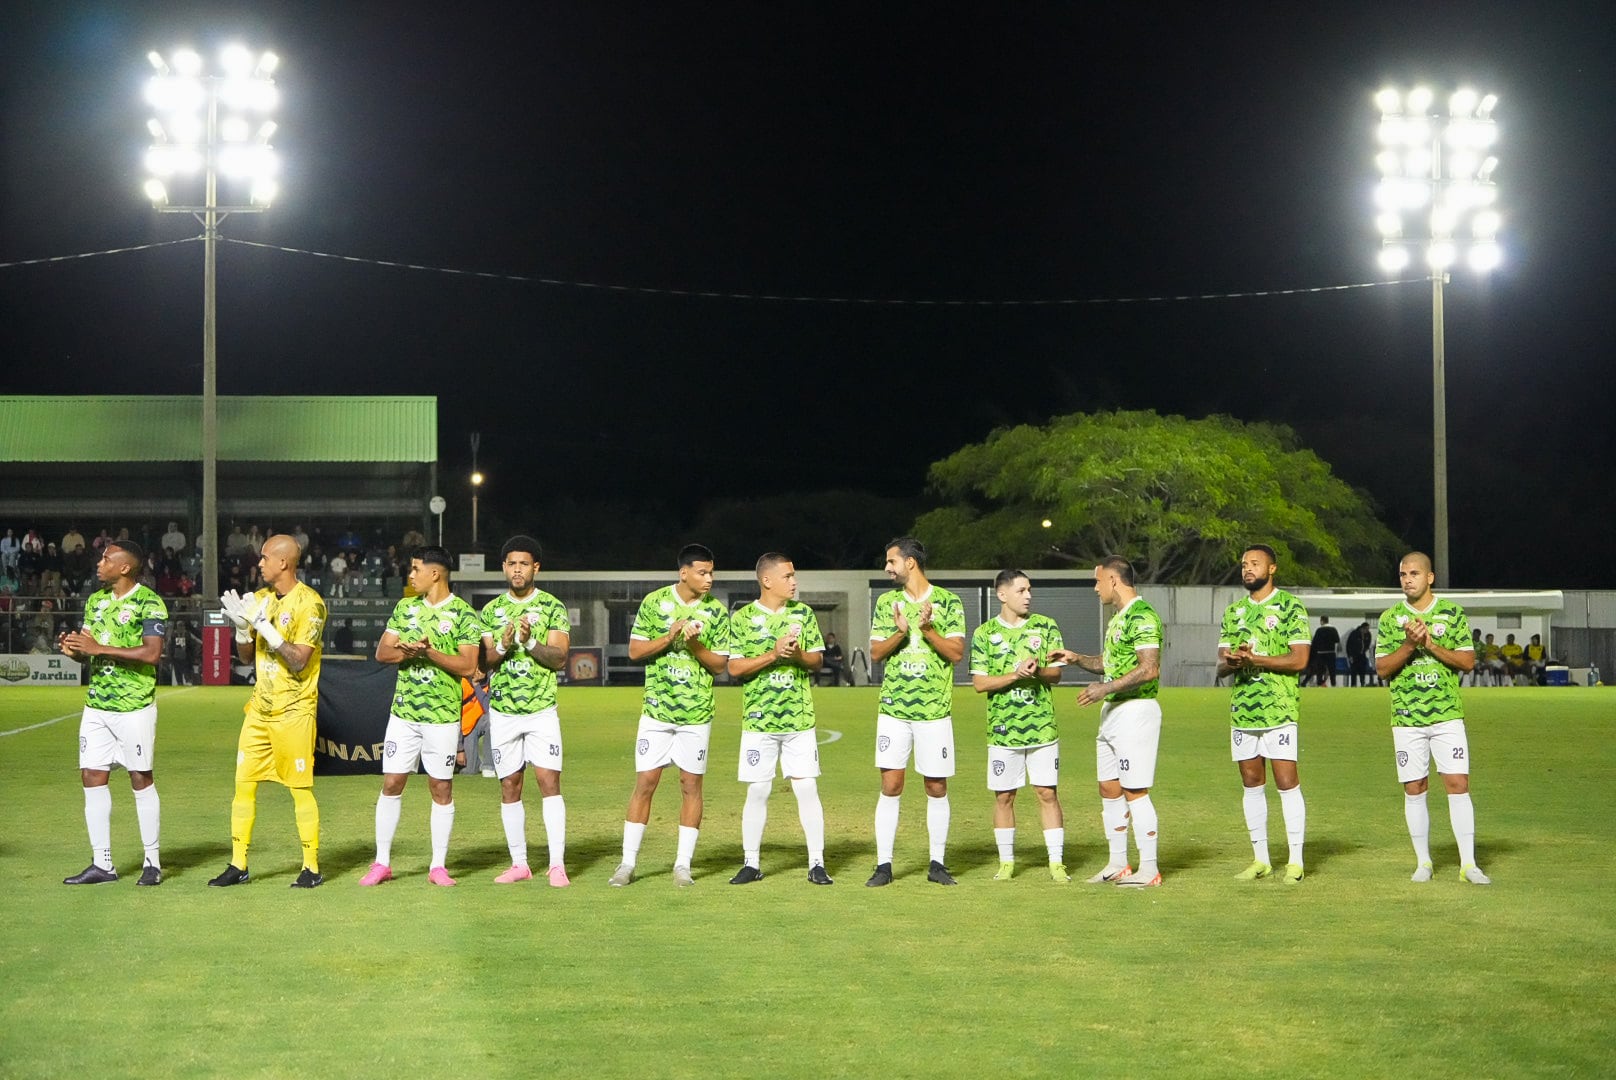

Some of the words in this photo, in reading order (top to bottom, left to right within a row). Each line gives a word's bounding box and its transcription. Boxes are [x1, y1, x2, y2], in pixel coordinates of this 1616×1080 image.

[48, 659, 61, 668] El
[902, 660, 927, 677] tigo
[668, 666, 691, 683] tigo
[770, 671, 794, 688] tigo
[1415, 669, 1438, 687] tigo
[1011, 688, 1035, 704] tigo
[1278, 733, 1290, 746] 24
[136, 744, 142, 756] 3
[549, 744, 560, 757] 53
[697, 750, 706, 761] 31
[941, 747, 948, 759] 6
[1452, 747, 1464, 760] 22
[445, 755, 456, 767] 25
[1119, 758, 1130, 771] 33
